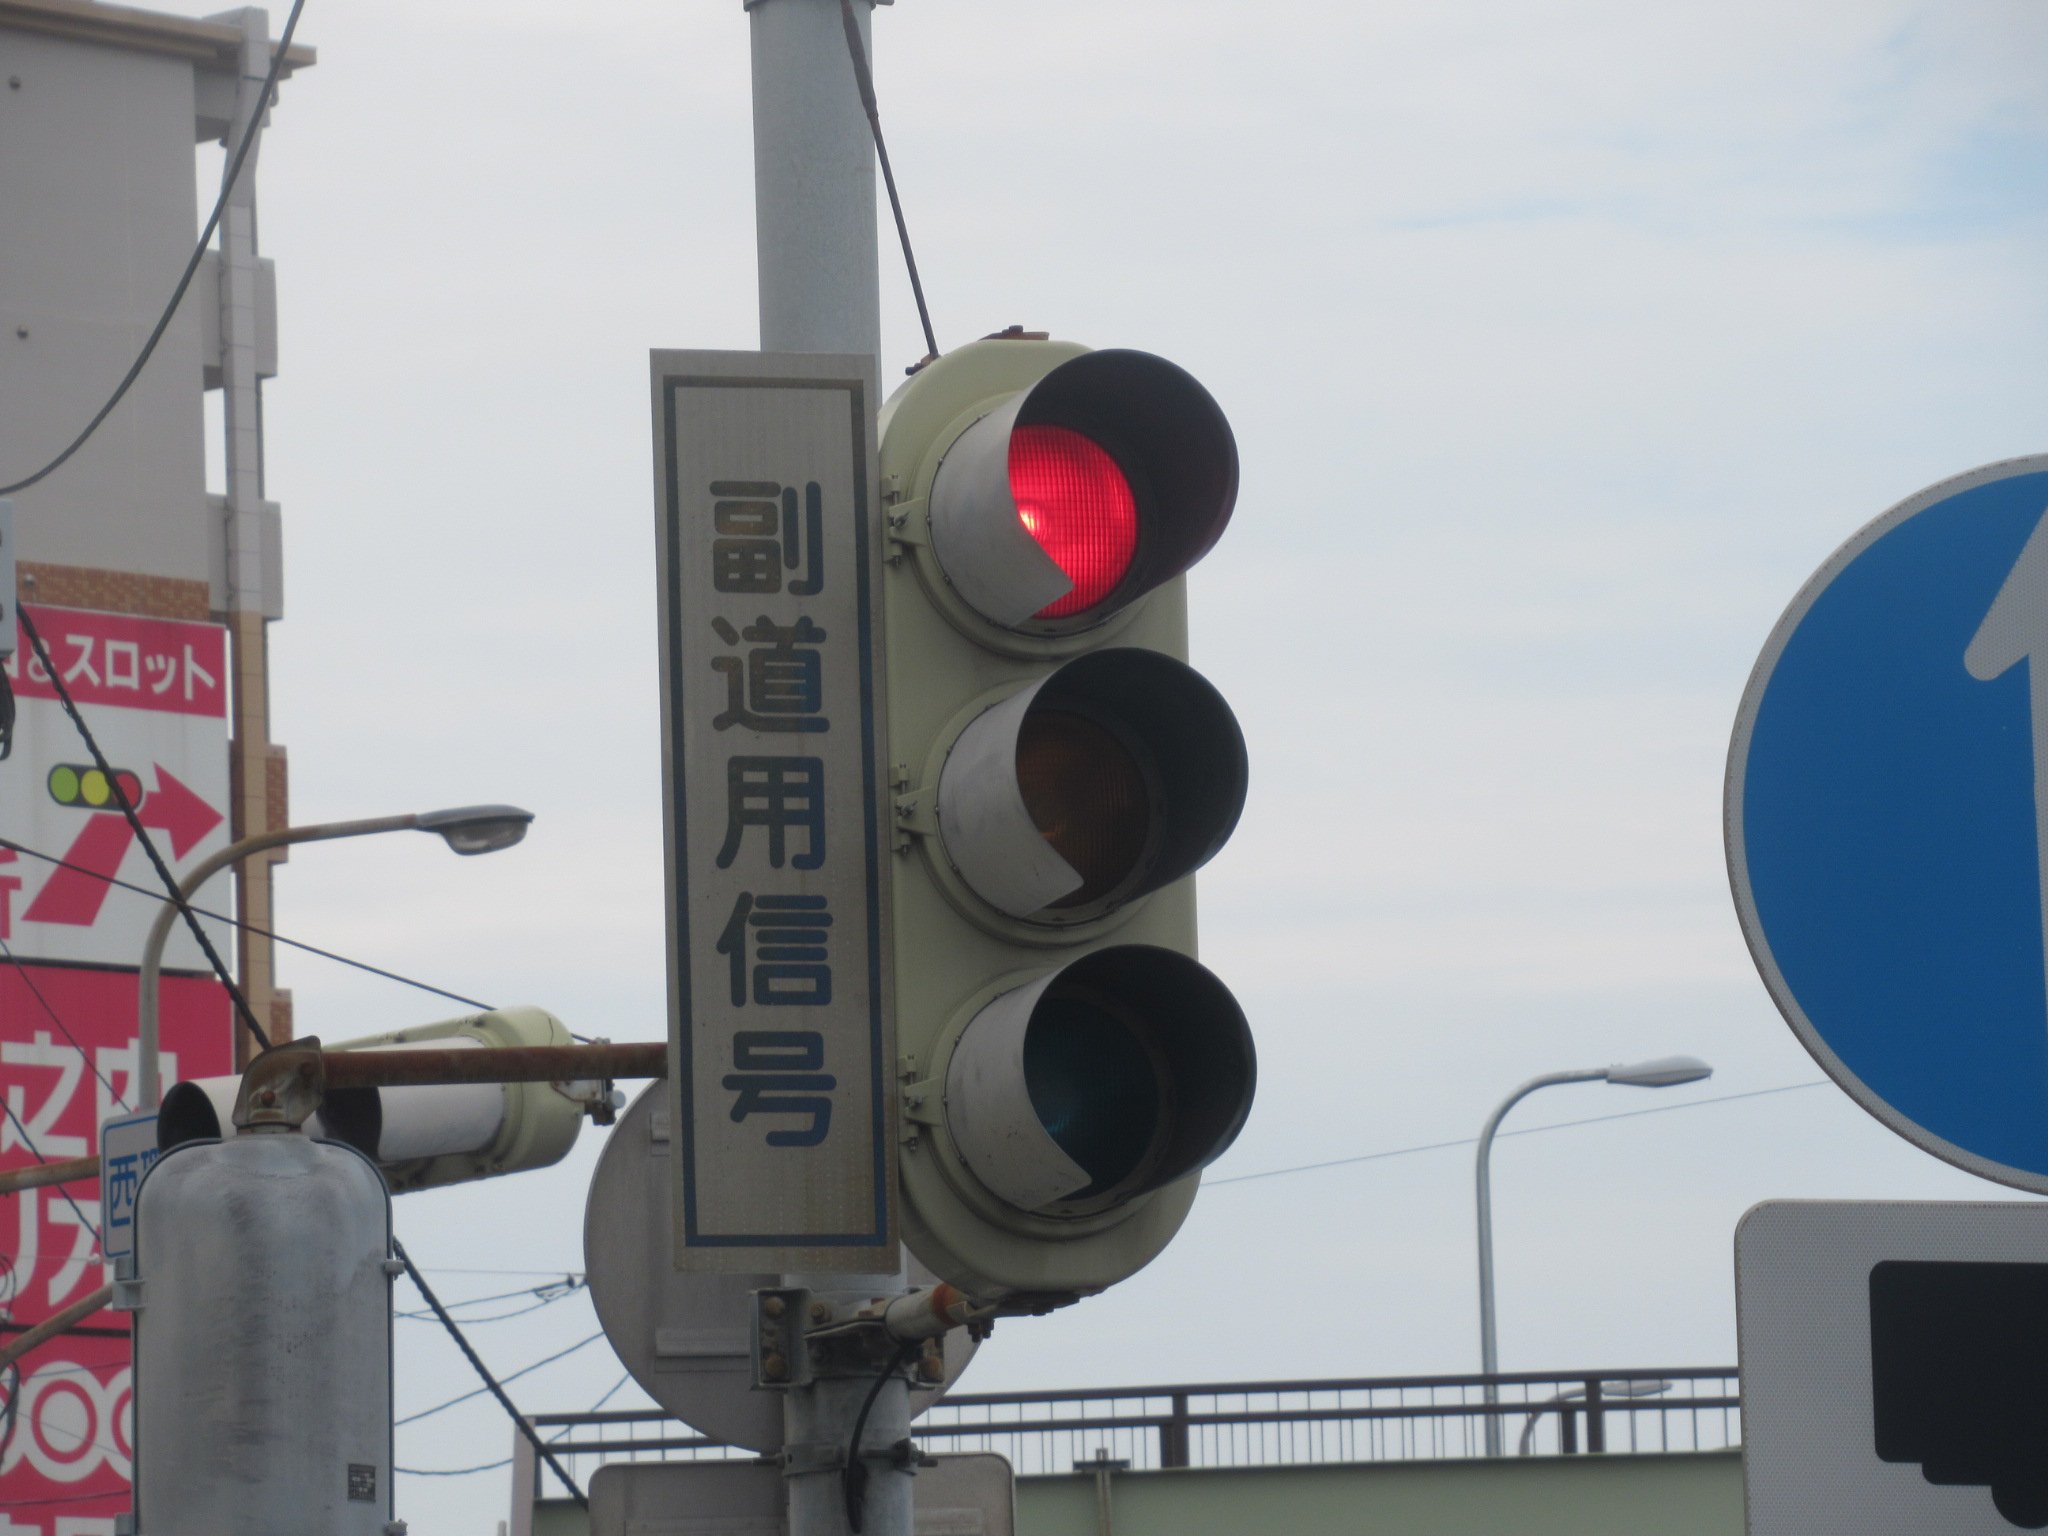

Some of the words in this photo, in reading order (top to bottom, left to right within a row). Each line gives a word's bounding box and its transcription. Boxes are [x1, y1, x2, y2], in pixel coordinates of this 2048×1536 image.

[3, 634, 216, 701] &スロット
[709, 480, 837, 1147] 副道用信号
